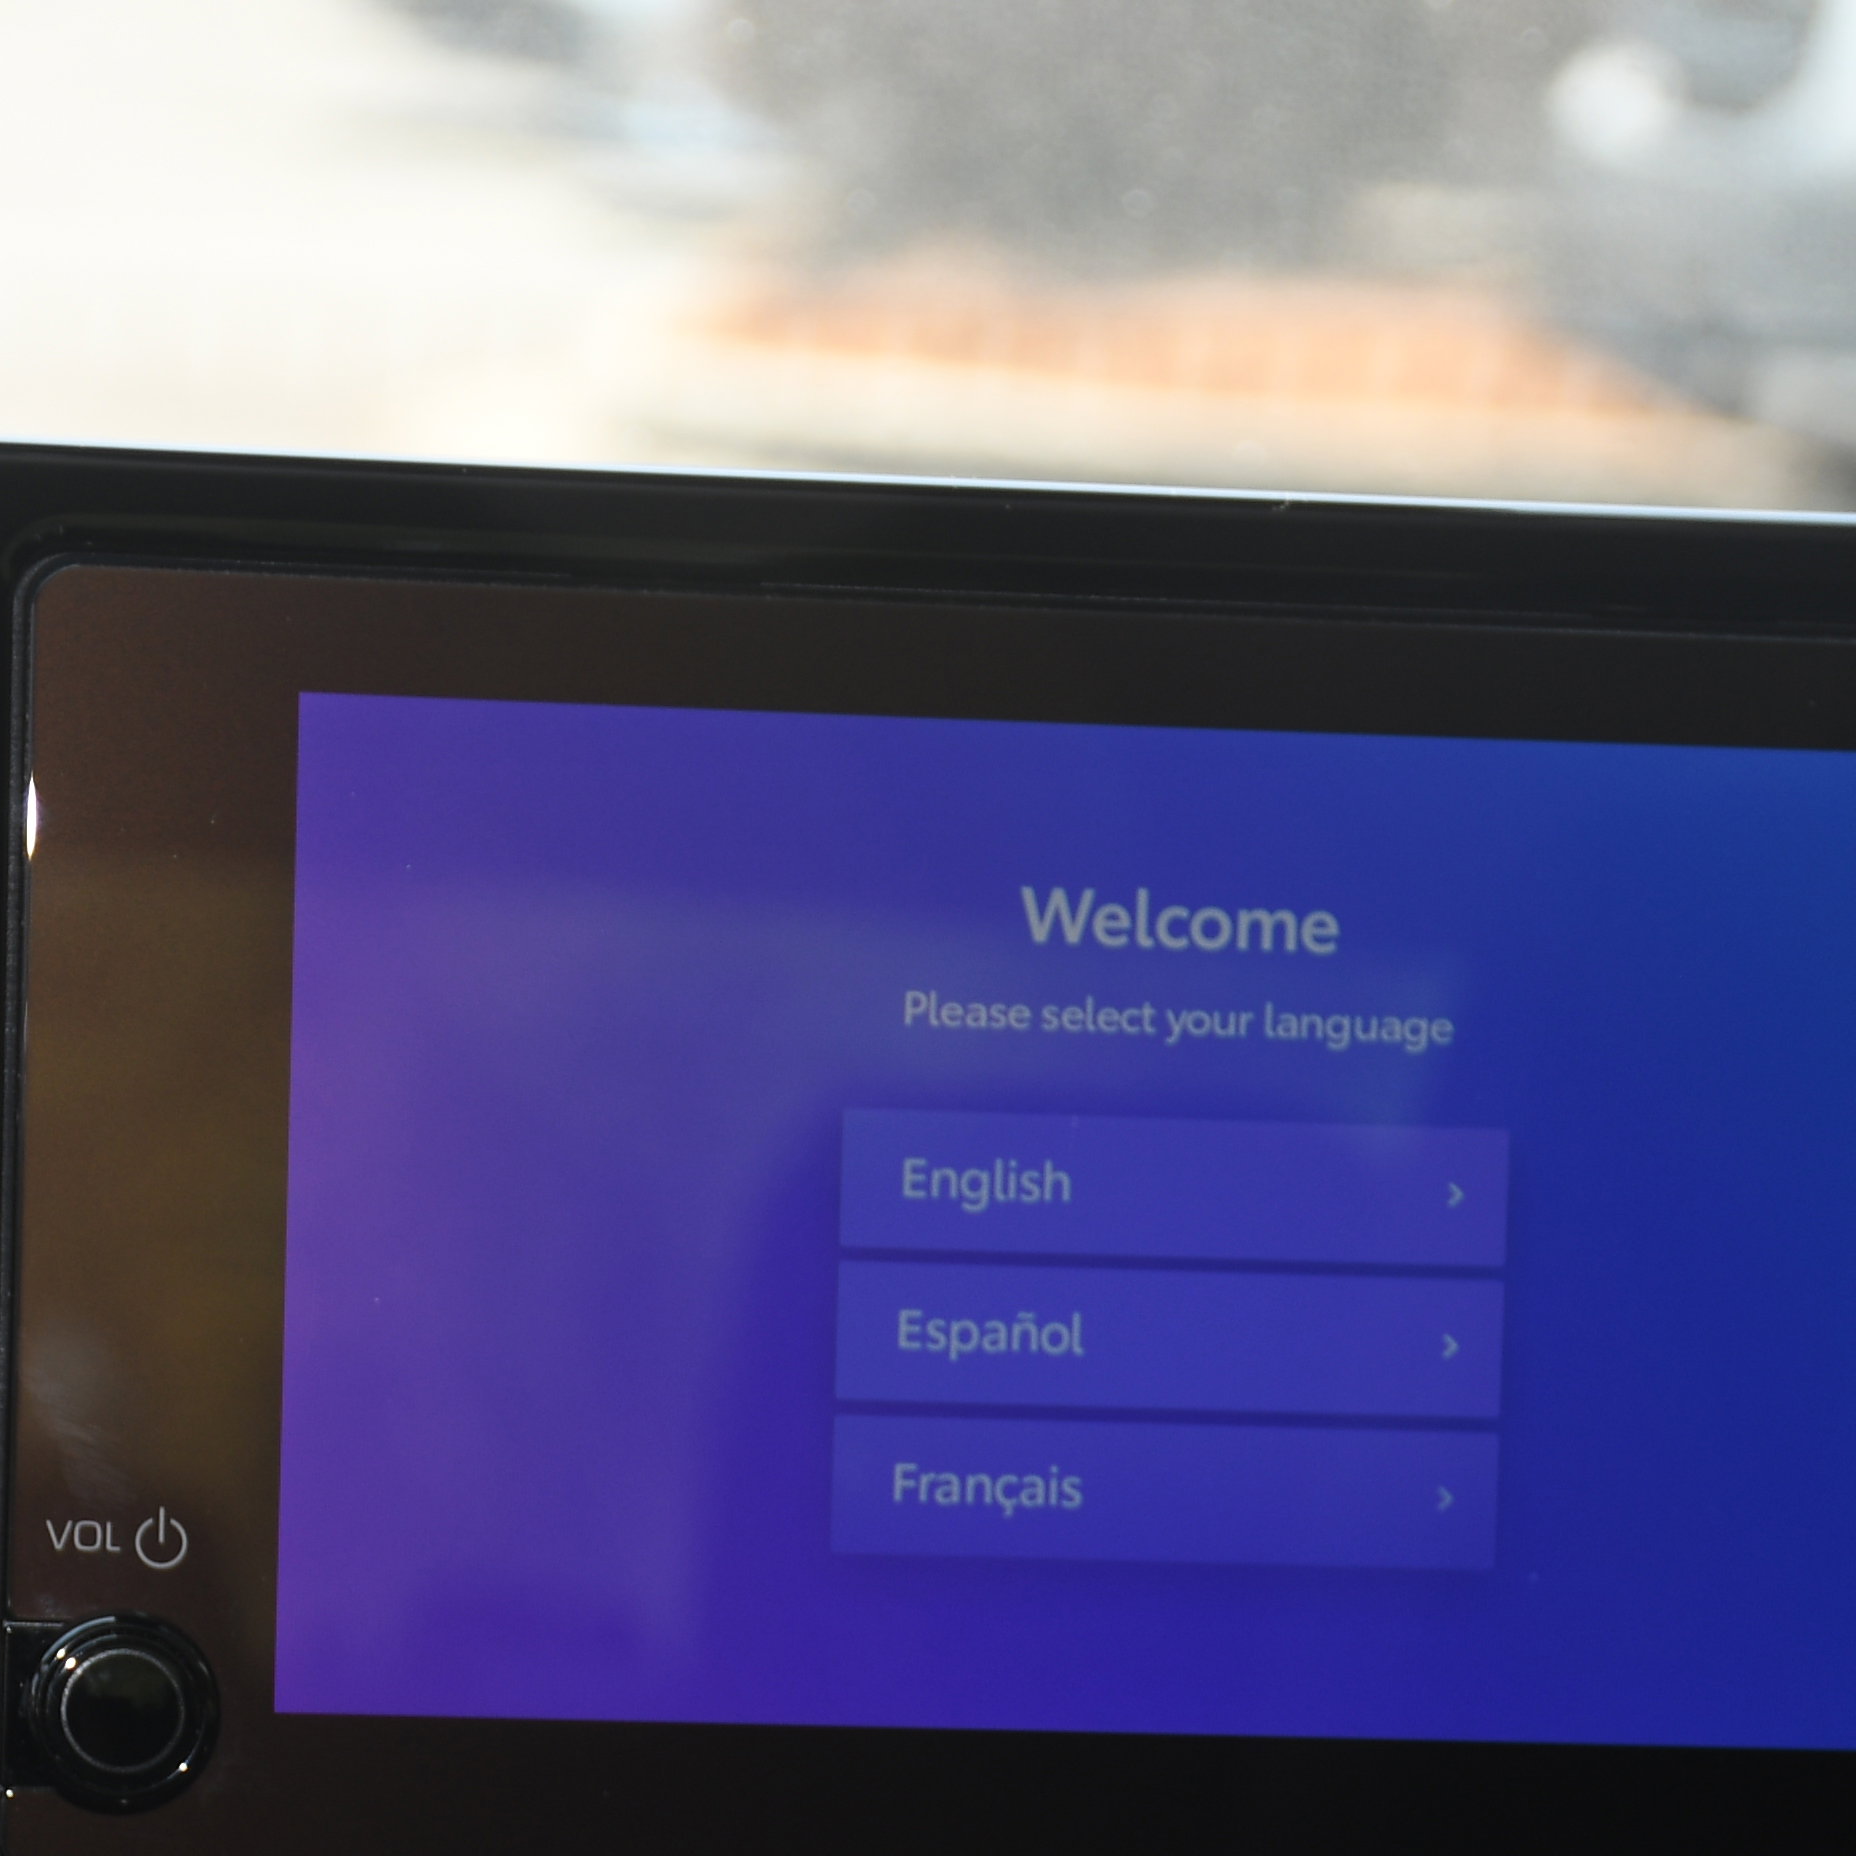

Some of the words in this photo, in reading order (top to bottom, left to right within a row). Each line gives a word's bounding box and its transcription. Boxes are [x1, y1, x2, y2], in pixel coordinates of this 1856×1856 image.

[1022, 886, 1339, 955] Welcome
[905, 991, 1031, 1029] Please
[1042, 996, 1156, 1034] select
[1166, 1010, 1254, 1045] your
[1265, 1002, 1453, 1053] language
[903, 1158, 1071, 1212] English
[898, 1309, 1083, 1361] Español
[894, 1463, 1082, 1516] Français
[46, 1520, 120, 1551] VOL
